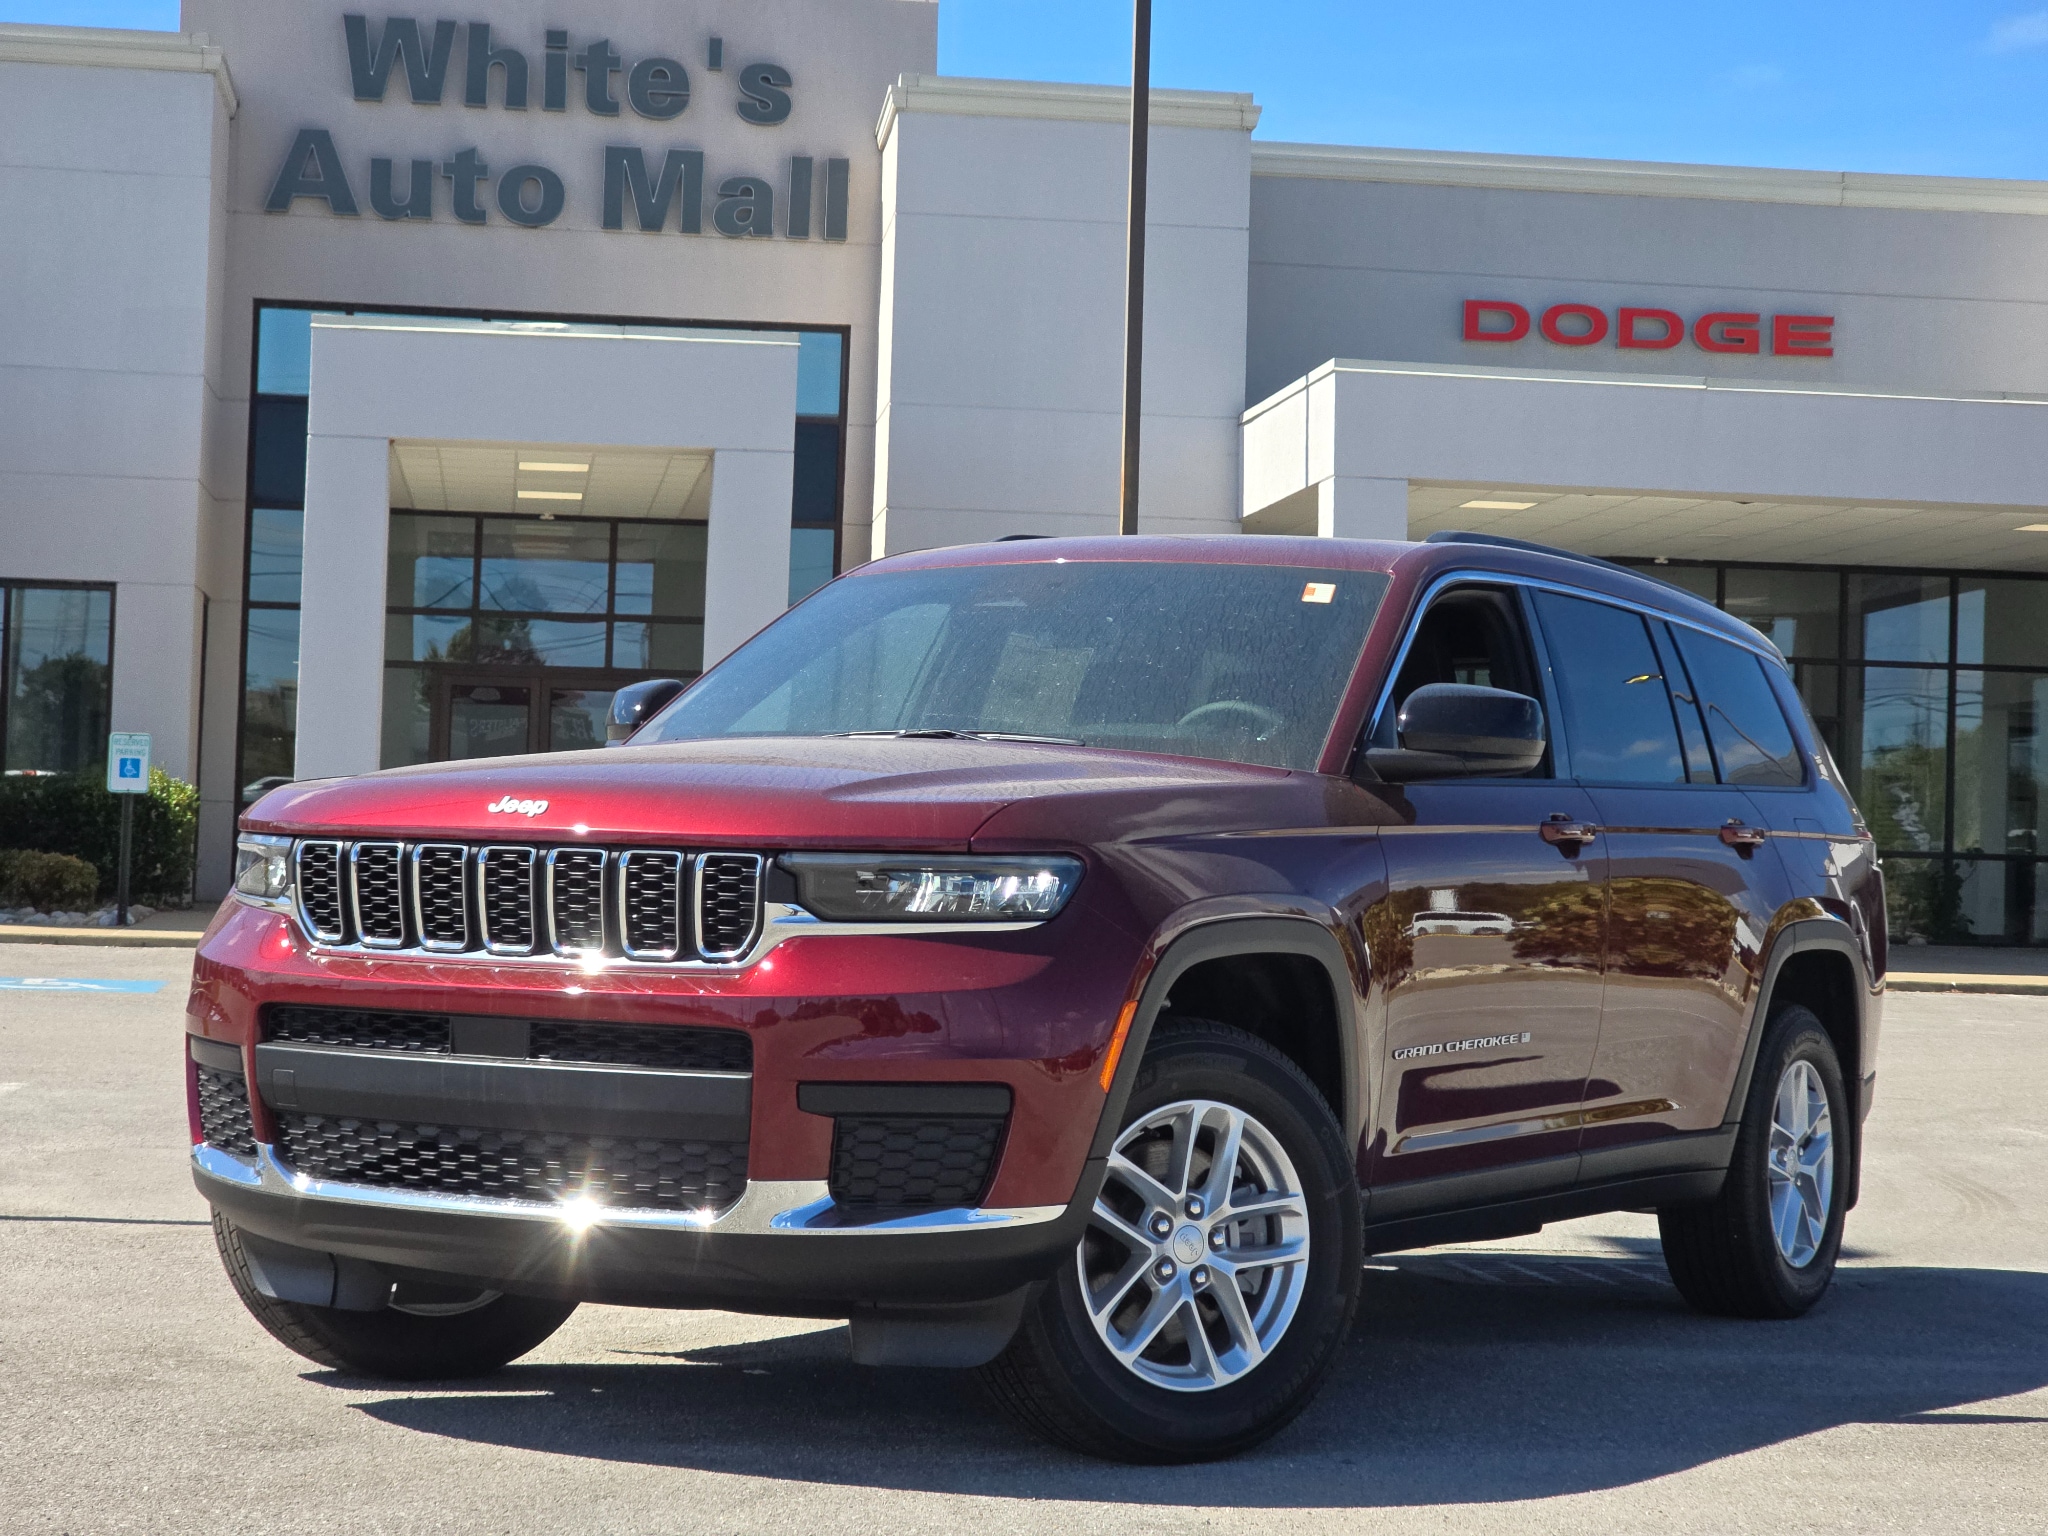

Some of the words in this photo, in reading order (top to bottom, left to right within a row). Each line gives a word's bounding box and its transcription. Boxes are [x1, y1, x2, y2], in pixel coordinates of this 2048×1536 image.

[343, 13, 794, 125] White's
[264, 128, 566, 228] Auto
[600, 145, 850, 242] Mall
[1463, 299, 1835, 357] DODGE
[113, 738, 149, 747] RESERVED
[115, 748, 146, 756] PARKING
[487, 795, 549, 818] Jeep
[1393, 1044, 1442, 1060] GRAND
[1445, 1033, 1519, 1053] CHEROKEE
